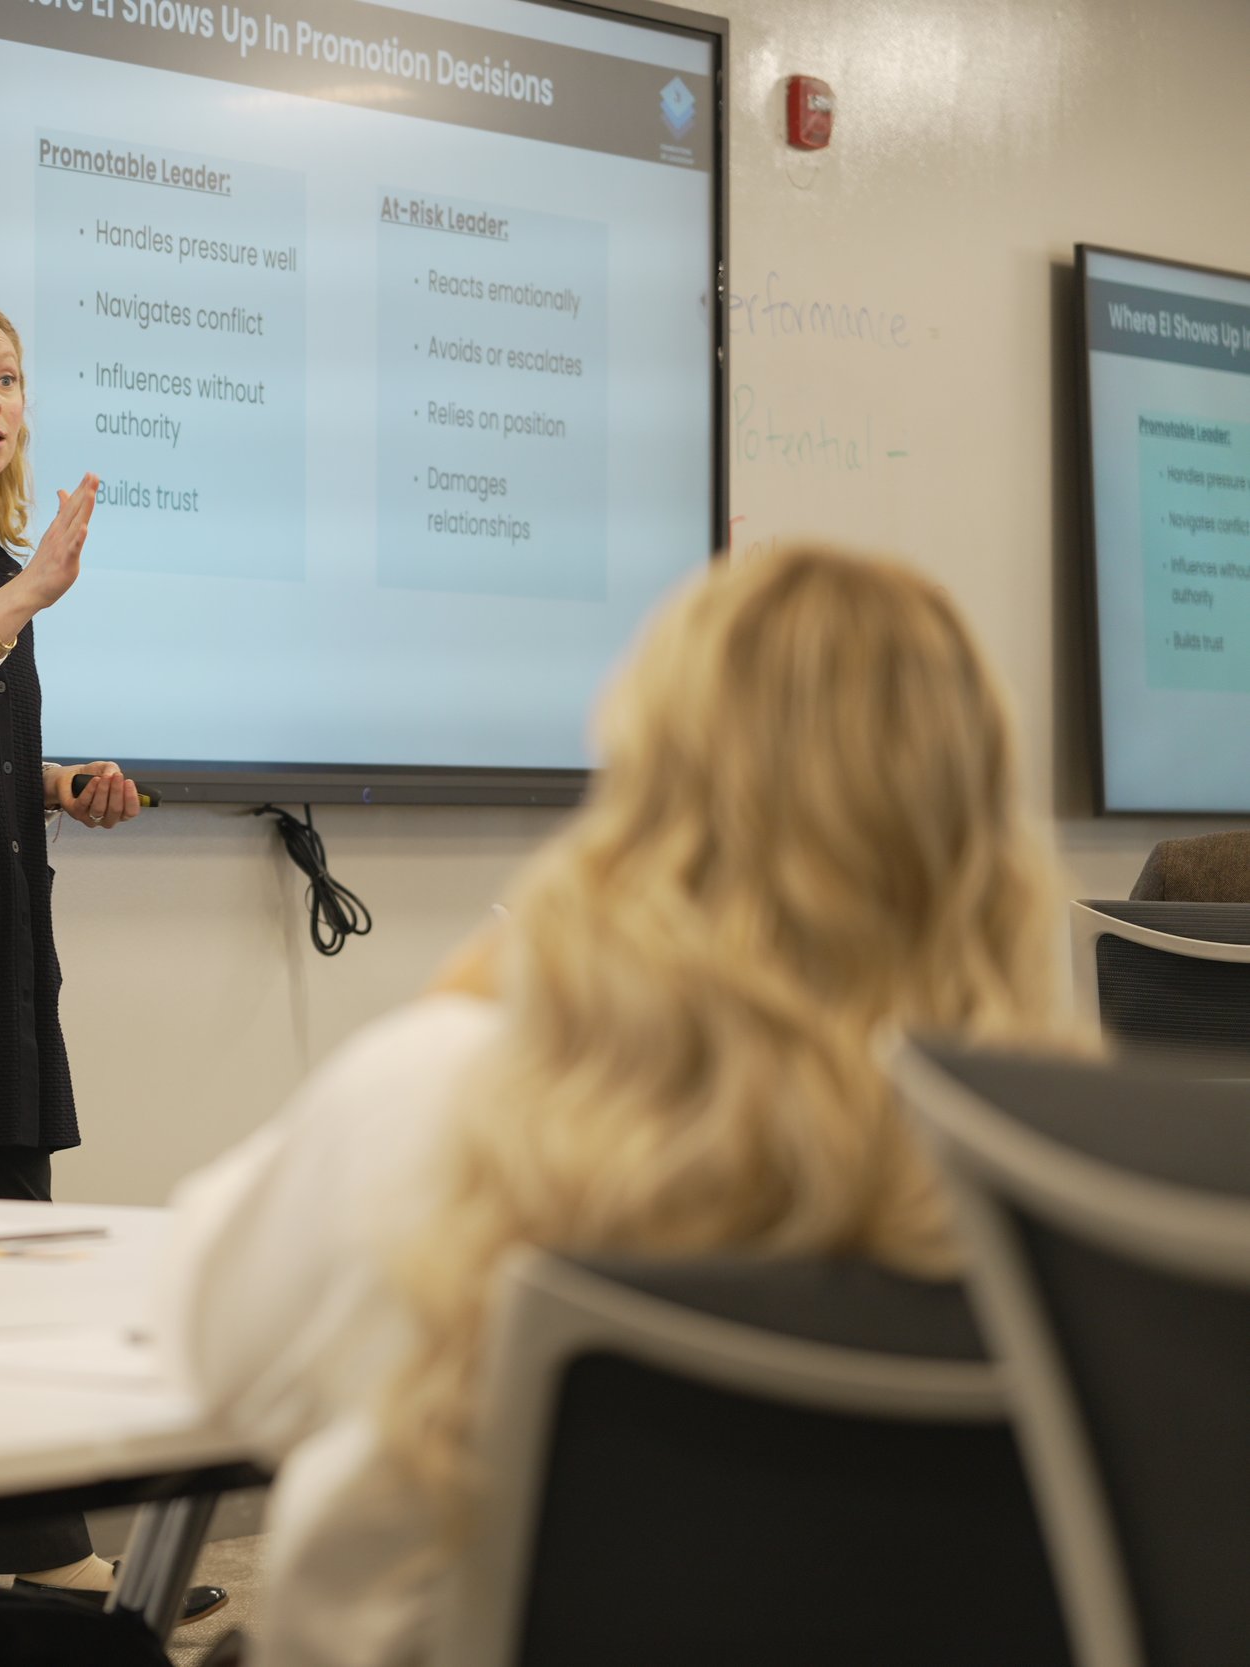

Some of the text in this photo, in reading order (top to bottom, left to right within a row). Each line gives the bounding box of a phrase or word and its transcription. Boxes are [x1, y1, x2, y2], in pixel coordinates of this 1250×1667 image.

[221, 5, 258, 58] Up
[265, 14, 290, 54] In
[297, 21, 430, 83] Promotion
[437, 50, 554, 106] Decisions
[39, 138, 231, 195] Promotable Leader:
[381, 196, 509, 240] At-Risk Leader:
[96, 219, 297, 272] Handles pressure well
[96, 291, 263, 336] Navigates conflict
[428, 269, 580, 319] Reacts emotionally
[1108, 302, 1157, 335] Where
[1173, 312, 1218, 346] Shows
[1221, 320, 1240, 358] Up
[428, 335, 582, 378] Avoids or escalates
[96, 362, 265, 405] Influences without
[95, 410, 181, 448] authority
[427, 400, 566, 439] Relies on position
[95, 479, 199, 513] Builds trust
[427, 466, 507, 502] Damages
[427, 509, 531, 546] relationships
